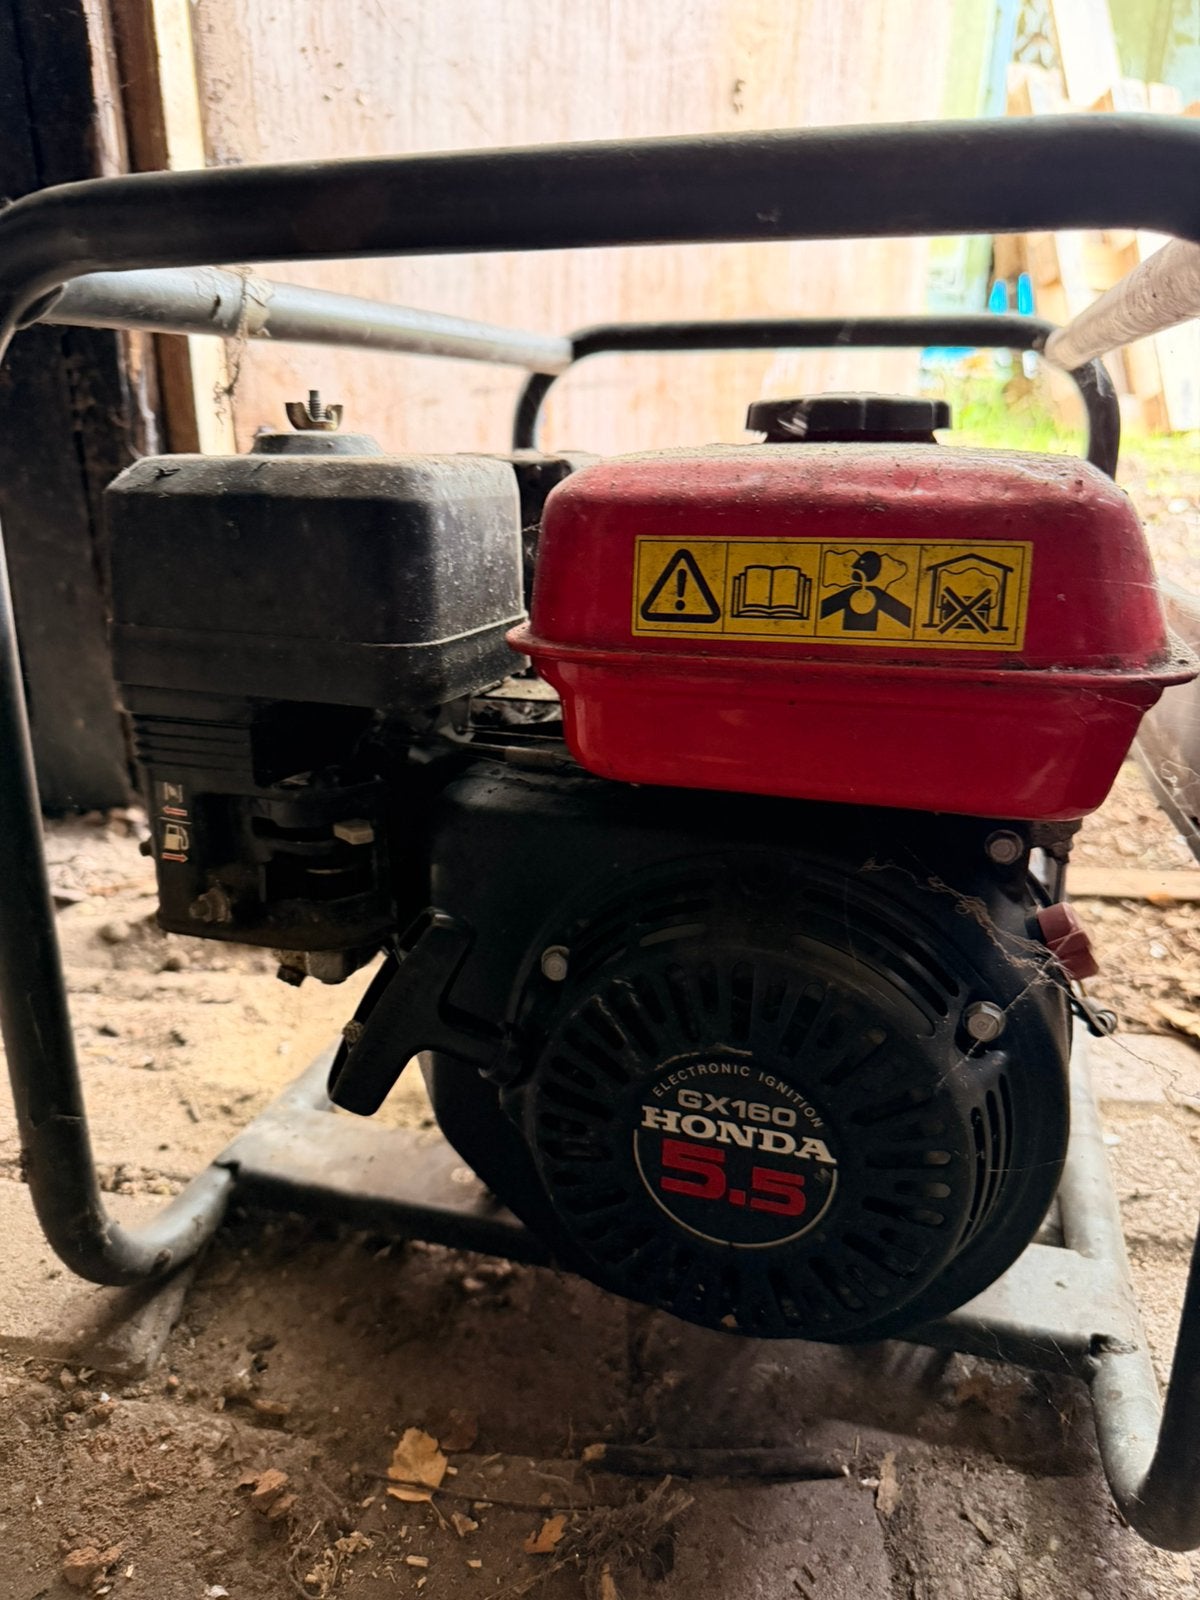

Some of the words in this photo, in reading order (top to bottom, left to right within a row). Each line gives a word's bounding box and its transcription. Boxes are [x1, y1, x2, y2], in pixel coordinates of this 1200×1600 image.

[652, 1062, 751, 1098] ELECTRONIC
[758, 1071, 825, 1128] IGNITION
[677, 1088, 798, 1128] GX160
[641, 1105, 838, 1164] HONDA
[660, 1137, 807, 1217] 5.5
